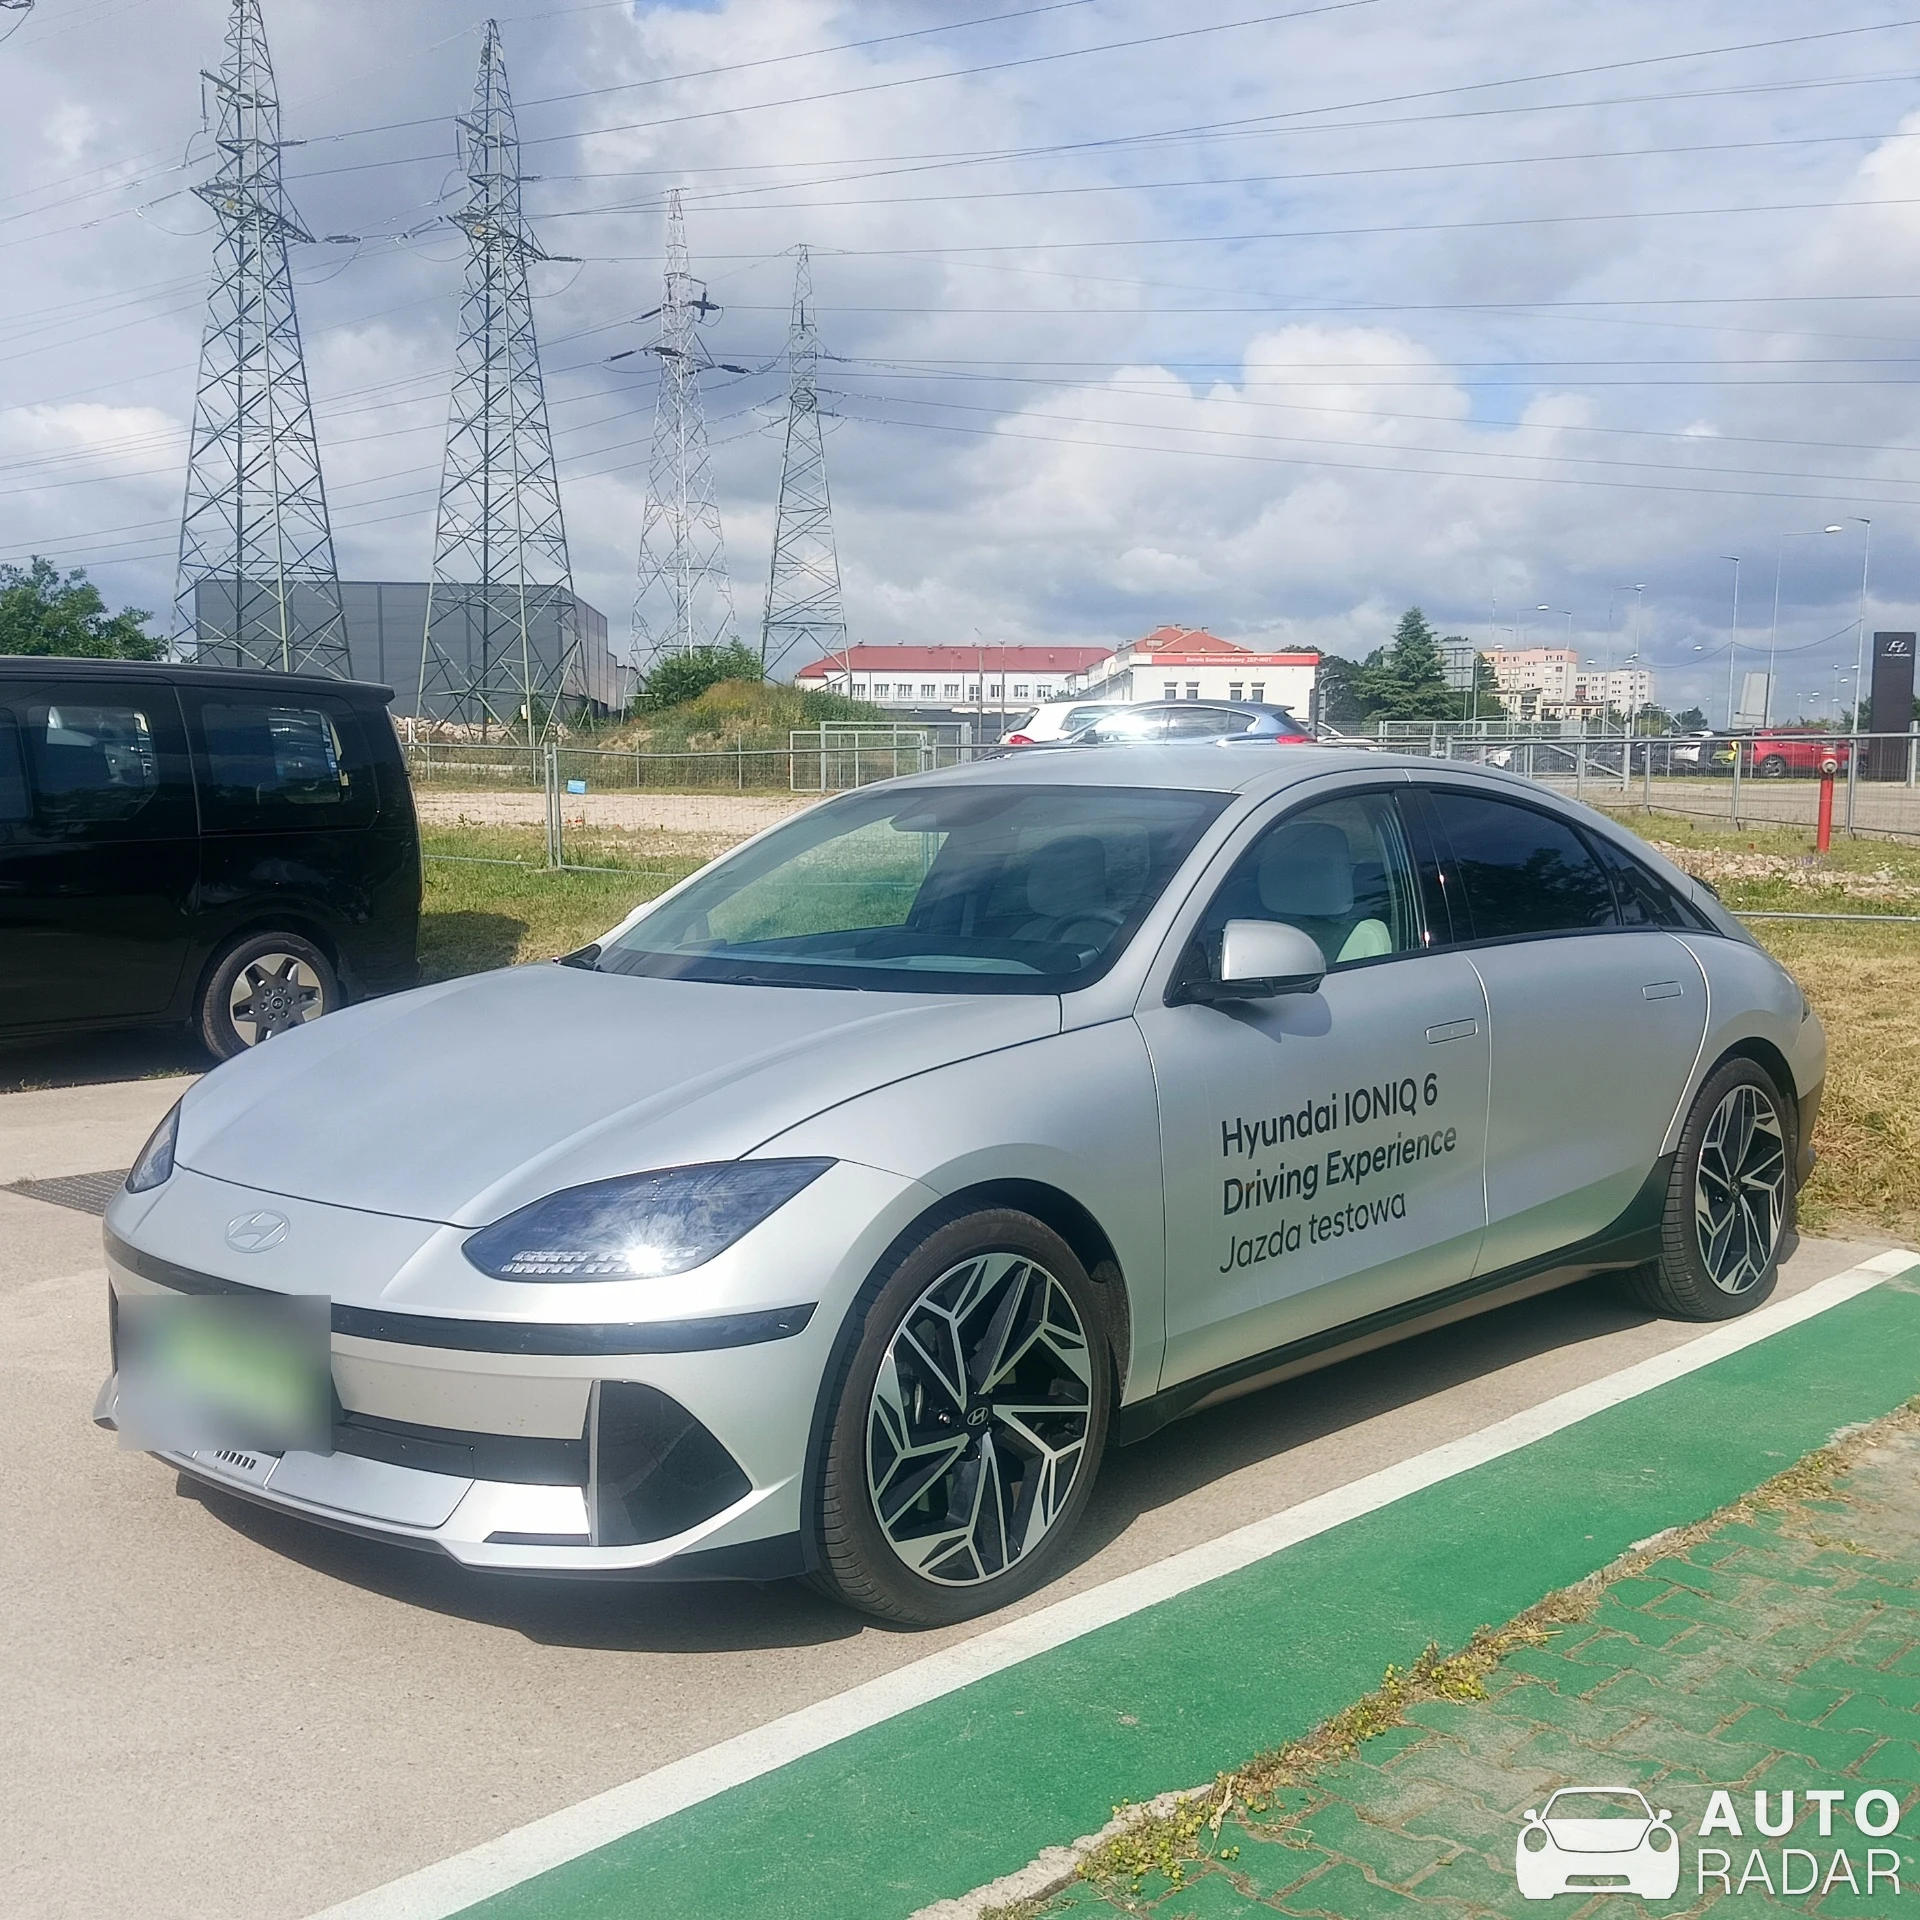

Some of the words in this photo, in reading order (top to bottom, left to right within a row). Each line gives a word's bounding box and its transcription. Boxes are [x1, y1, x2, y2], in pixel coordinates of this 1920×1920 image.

[1221, 1093, 1337, 1160] Hyundai
[1345, 1078, 1417, 1126] IONIQ
[1423, 1072, 1437, 1106] 6
[1223, 1163, 1318, 1215] Driving
[1326, 1126, 1456, 1186] Experience
[1220, 1219, 1301, 1273] Jazda
[1309, 1192, 1406, 1245] testowa
